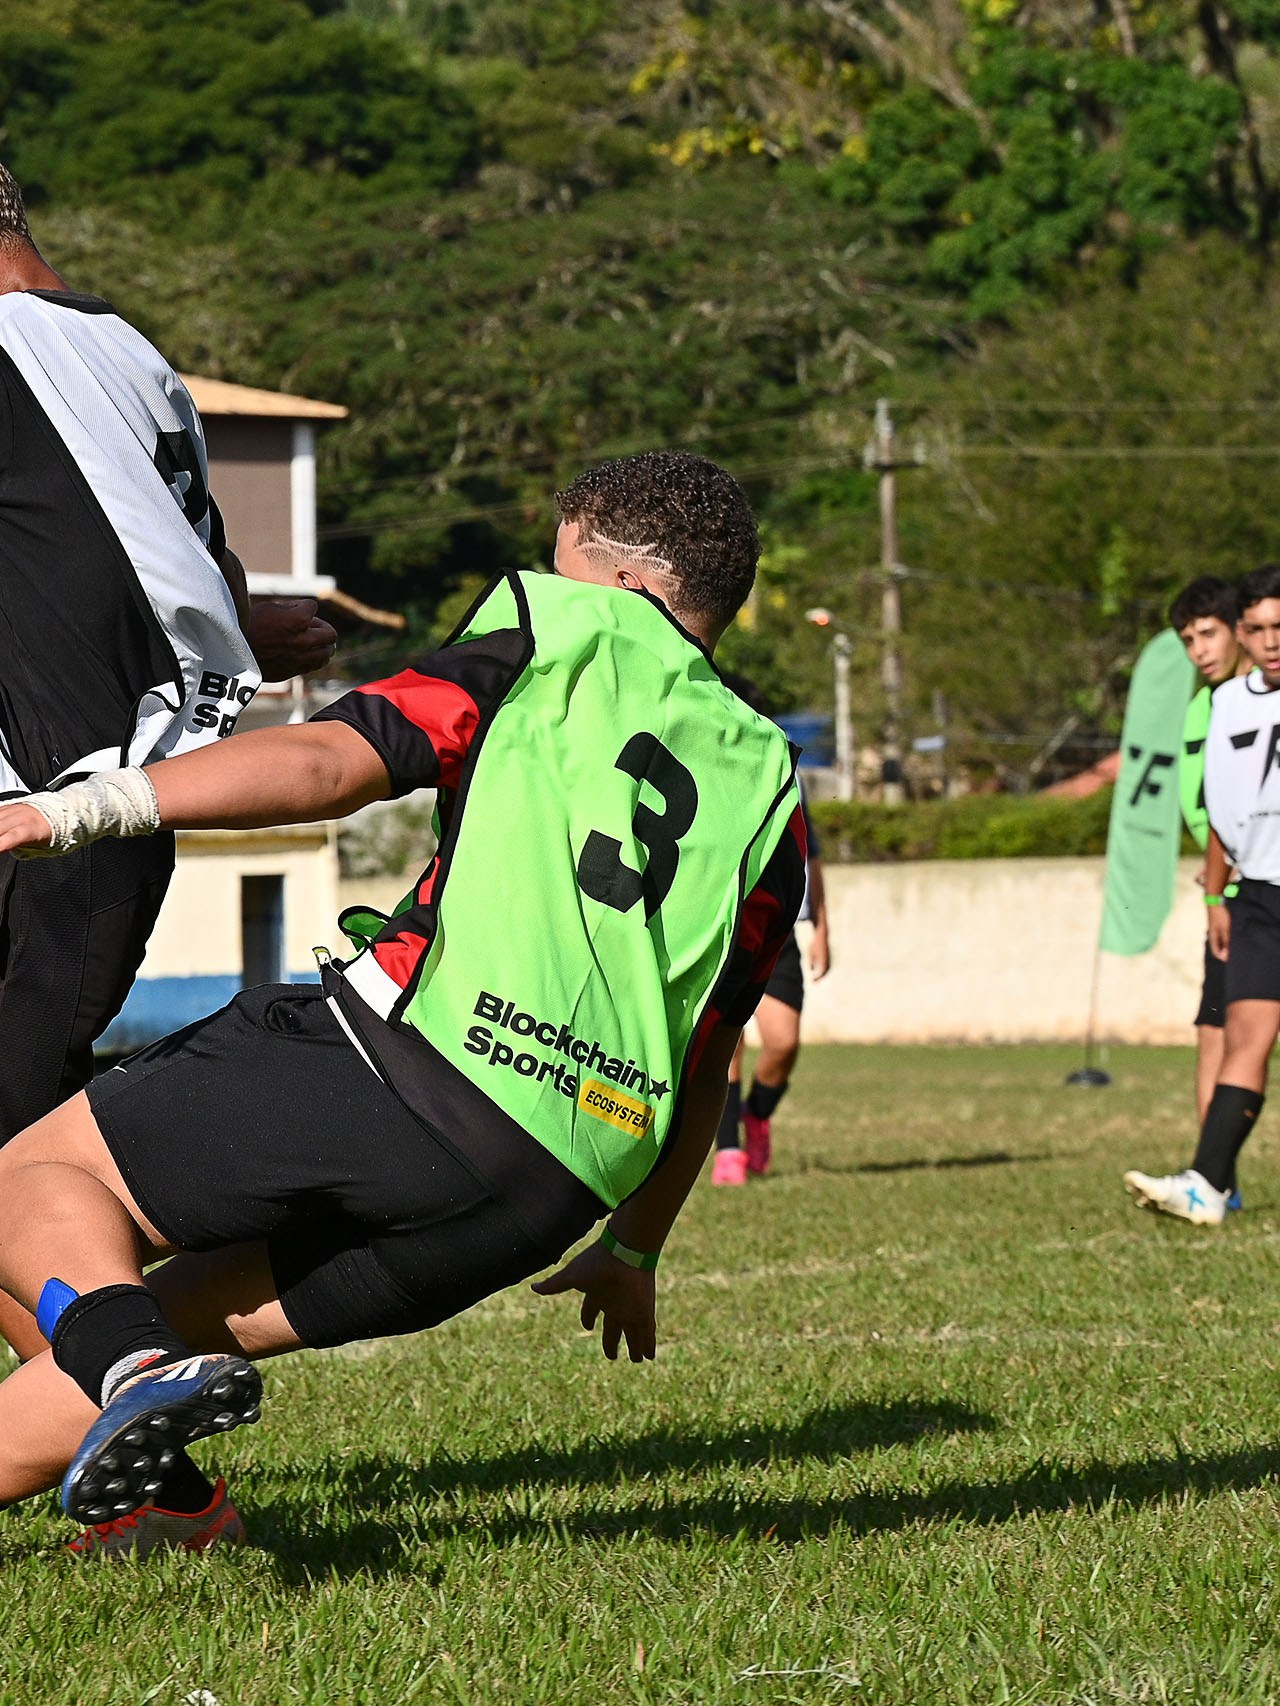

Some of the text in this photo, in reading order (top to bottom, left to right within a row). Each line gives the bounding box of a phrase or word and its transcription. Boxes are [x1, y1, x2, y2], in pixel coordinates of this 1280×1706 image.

[577, 731, 699, 926] 3
[464, 1026, 650, 1131] Sports ECOSYSTEM
[473, 990, 648, 1095] Blockchain
